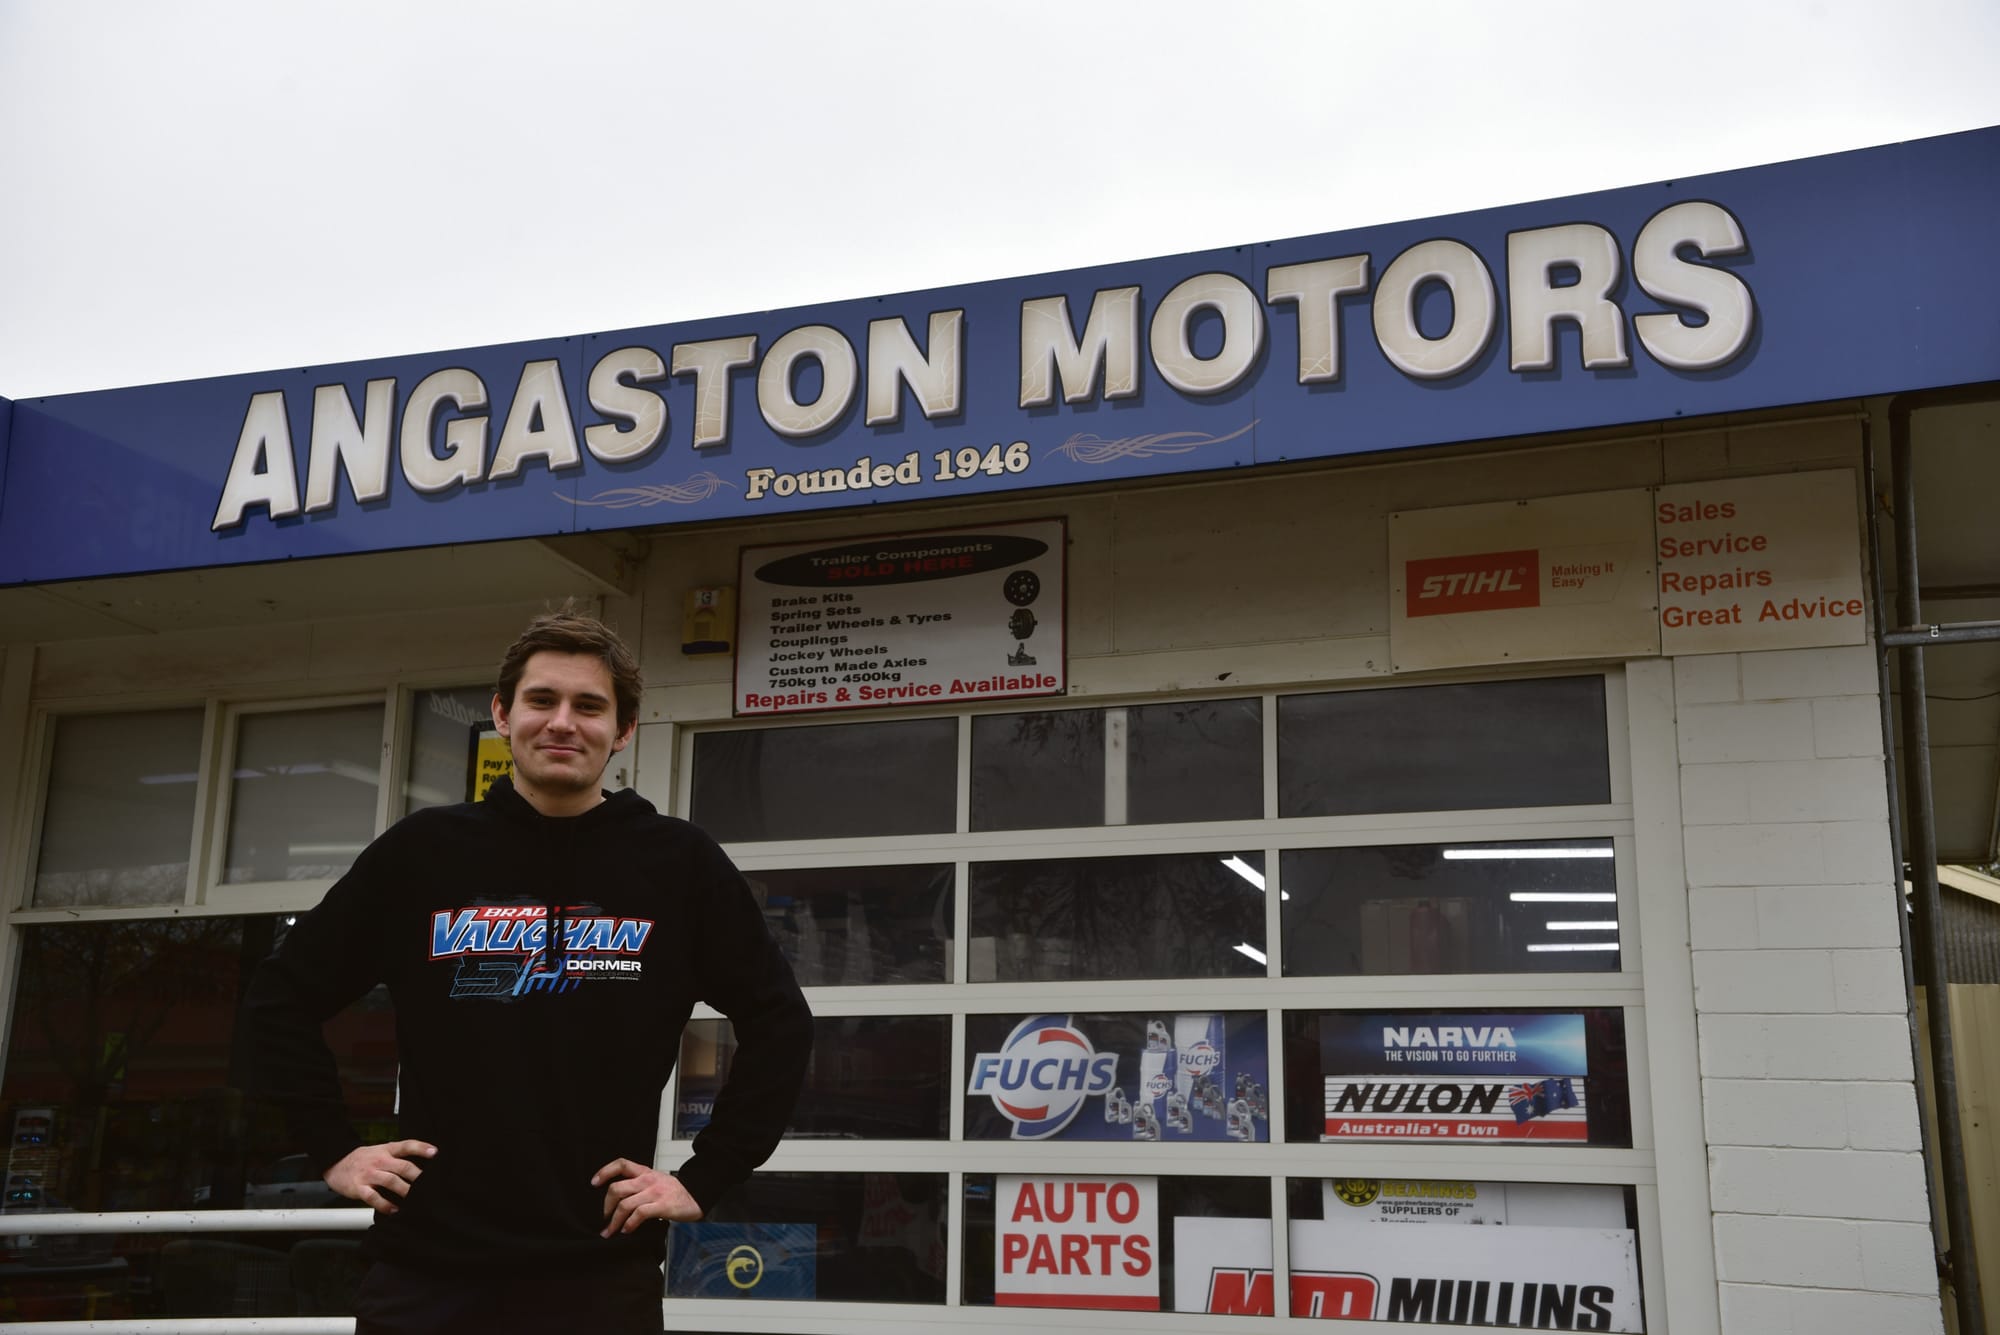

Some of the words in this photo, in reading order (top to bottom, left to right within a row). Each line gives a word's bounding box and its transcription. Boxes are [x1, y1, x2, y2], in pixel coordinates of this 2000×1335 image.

[211, 308, 966, 532] ANGASTON
[1019, 199, 1757, 408] MOTORS
[744, 453, 921, 500] Founded
[934, 441, 1031, 482] 1946
[1658, 502, 1737, 524] Sales
[811, 552, 872, 567] Trailer
[877, 542, 993, 560] Components
[1660, 532, 1768, 558] Service
[828, 562, 895, 580] SOLD
[904, 555, 974, 573] HERE
[1551, 563, 1600, 576] Making
[1419, 569, 1522, 599] STIHL
[1552, 574, 1585, 588] Easy
[1661, 567, 1773, 596] Repairs
[771, 595, 817, 608] Brake
[822, 592, 854, 603] Kits
[771, 609, 821, 622] Spring
[826, 606, 861, 617] Sets
[1663, 603, 1743, 628] Great
[1758, 595, 1864, 622] Advice
[770, 622, 821, 634] Trailer
[827, 618, 884, 630] Wheels
[889, 616, 901, 625] &
[906, 612, 952, 625] Tyres
[769, 634, 848, 648] Couplings
[769, 650, 824, 662] Jockey
[830, 645, 888, 657] Wheels
[769, 664, 829, 676] Custom
[834, 661, 878, 672] Made
[883, 657, 927, 668] Axles
[769, 676, 816, 688] 750kg
[822, 675, 837, 685] to
[842, 671, 901, 683] 4500kg
[745, 690, 828, 709] Repairs
[835, 687, 851, 702] &
[858, 681, 942, 699] Service
[950, 673, 1057, 695] Available
[483, 760, 503, 771] Pay
[431, 909, 652, 957] VAUGHAN
[566, 960, 641, 972] DORMER
[1383, 1027, 1516, 1048] NARVA
[1179, 1053, 1220, 1066] FUCHS
[1385, 1050, 1404, 1062] THE
[1406, 1050, 1439, 1062] VISION
[1442, 1050, 1454, 1062] TO
[1456, 1050, 1469, 1062] GO
[1472, 1050, 1517, 1063] FURTHER
[974, 1058, 1114, 1091] FUCHS
[1146, 1081, 1173, 1089] FUCHS
[1334, 1084, 1505, 1114] NULON
[1338, 1122, 1449, 1135] Australia's
[1457, 1124, 1499, 1136] Own
[1383, 1184, 1477, 1199] BEARINGS
[1011, 1182, 1140, 1224] AUTO
[1376, 1200, 1474, 1208] www.gardnerbearings.com.au
[1381, 1206, 1442, 1216] SUPPLIERS
[1446, 1207, 1460, 1216] OF
[1003, 1235, 1152, 1277] PARTS
[1388, 1277, 1614, 1331] MULLINS
